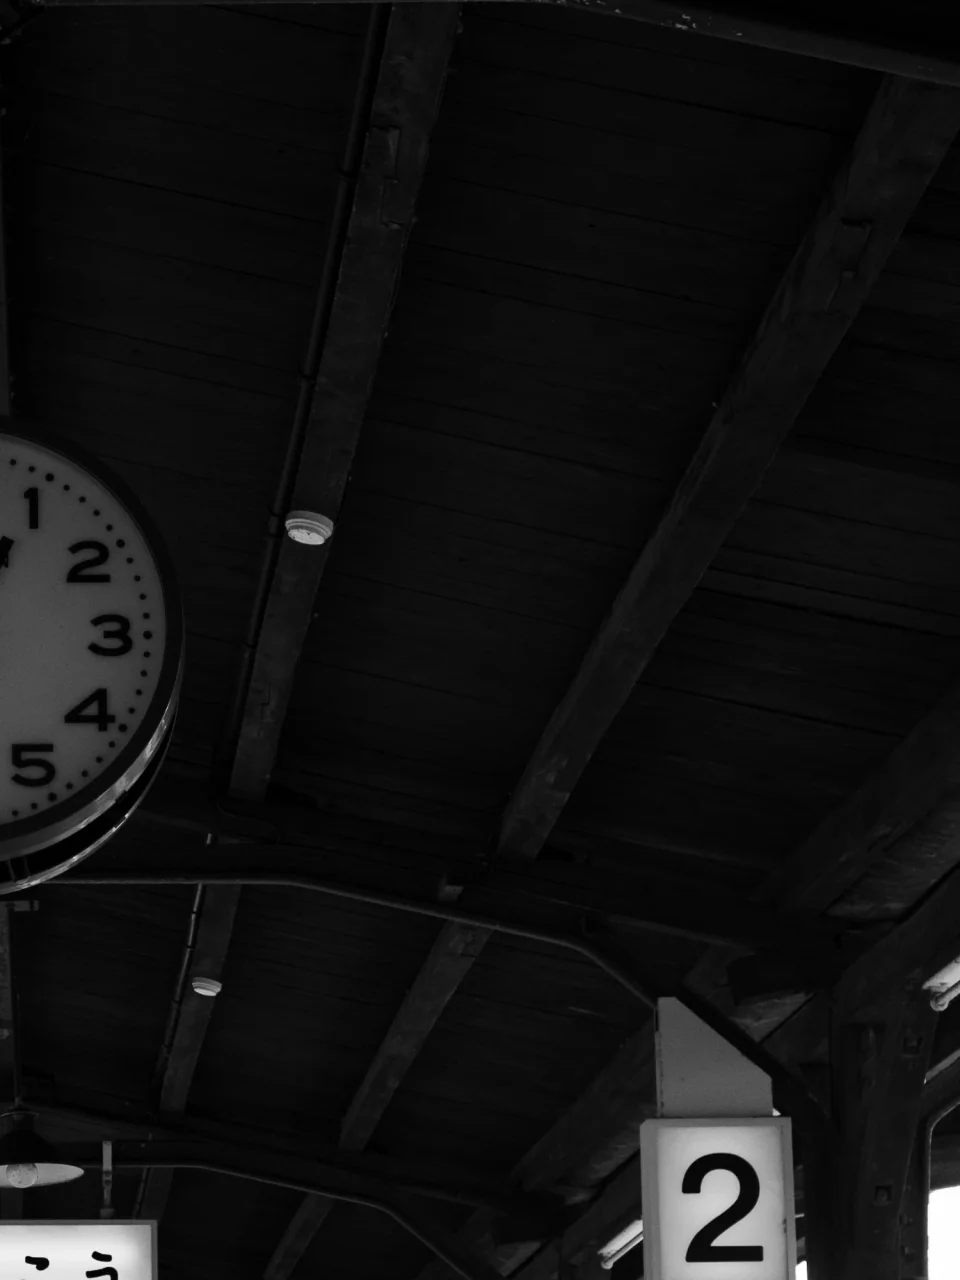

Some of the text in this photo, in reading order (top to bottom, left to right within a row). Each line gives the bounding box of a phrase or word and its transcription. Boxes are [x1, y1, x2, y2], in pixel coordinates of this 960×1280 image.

[24, 487, 39, 530] 1
[67, 540, 111, 583] 2
[88, 614, 133, 657] 3
[64, 688, 116, 732] 4
[11, 744, 56, 787] 5
[682, 1153, 764, 1262] 2
